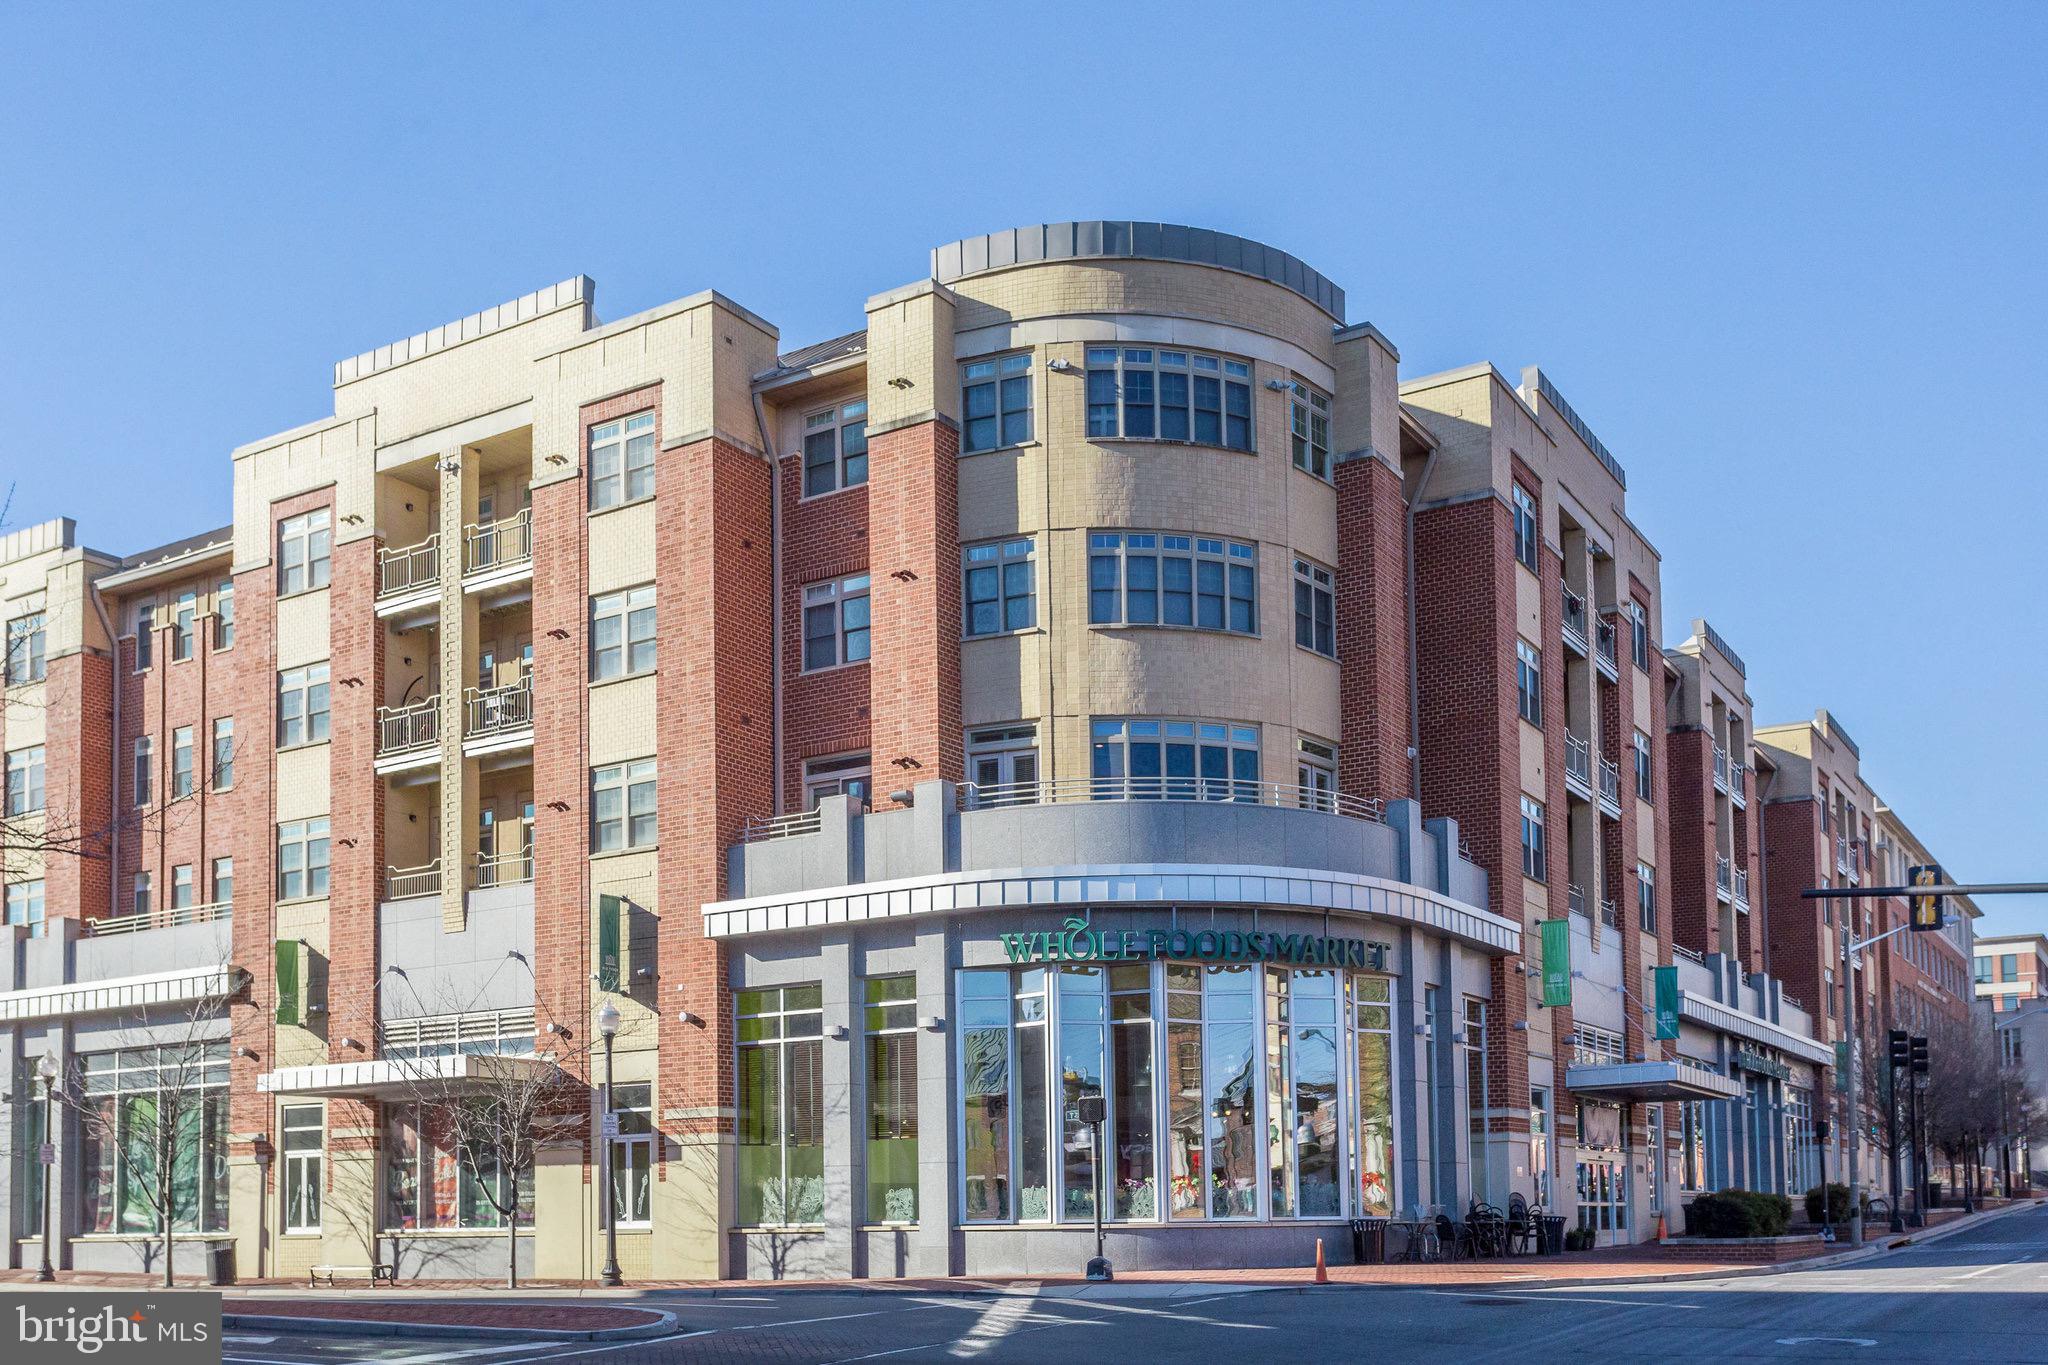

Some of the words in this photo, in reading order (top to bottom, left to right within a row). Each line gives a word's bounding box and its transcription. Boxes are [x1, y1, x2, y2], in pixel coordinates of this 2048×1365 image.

[1000, 914, 1140, 964] WHOLE
[1146, 928, 1267, 964] FOODS
[1268, 931, 1392, 972] MARKET
